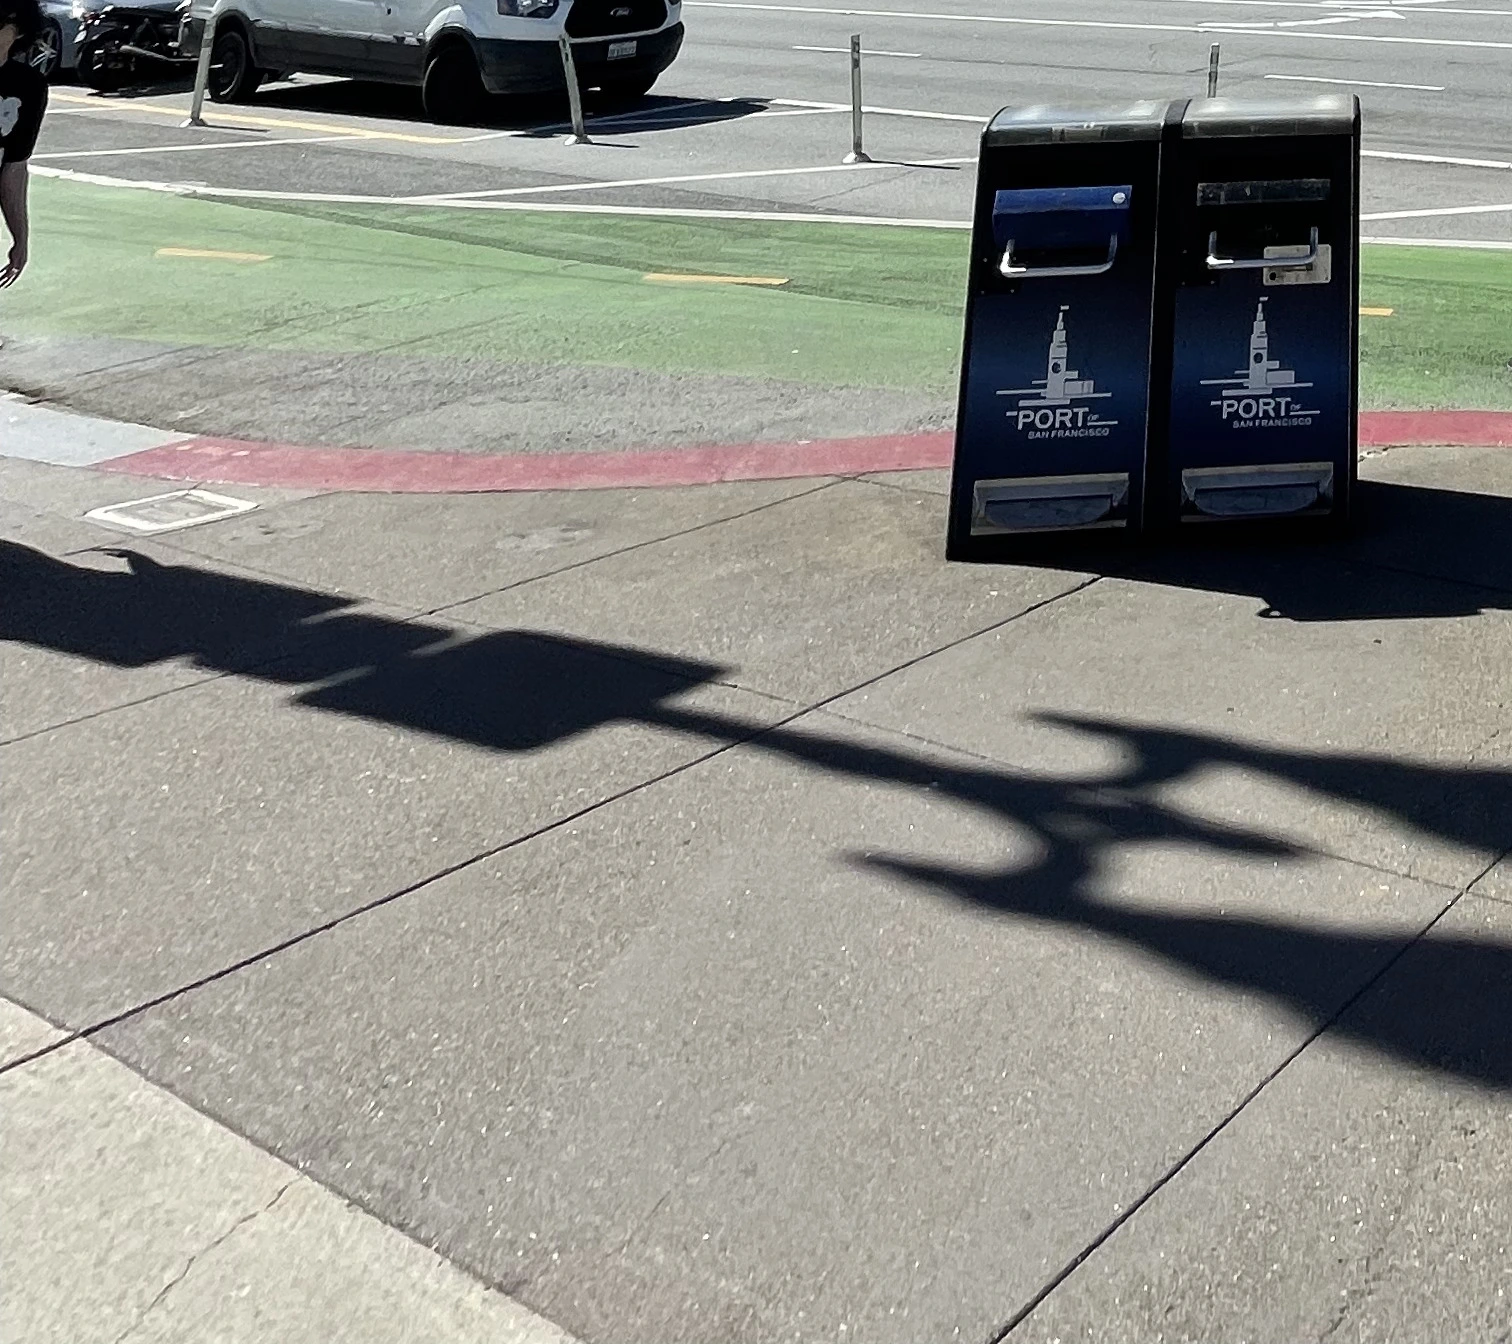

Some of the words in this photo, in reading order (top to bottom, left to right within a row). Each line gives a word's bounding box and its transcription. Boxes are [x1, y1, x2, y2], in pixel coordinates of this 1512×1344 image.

[1222, 397, 1291, 419] PORT
[1017, 407, 1090, 431] PORT
[1232, 419, 1254, 429] SAN
[1255, 417, 1312, 427] FRANCISCO
[1027, 431, 1049, 440] SAN
[1050, 428, 1110, 439] FRANCISCO
